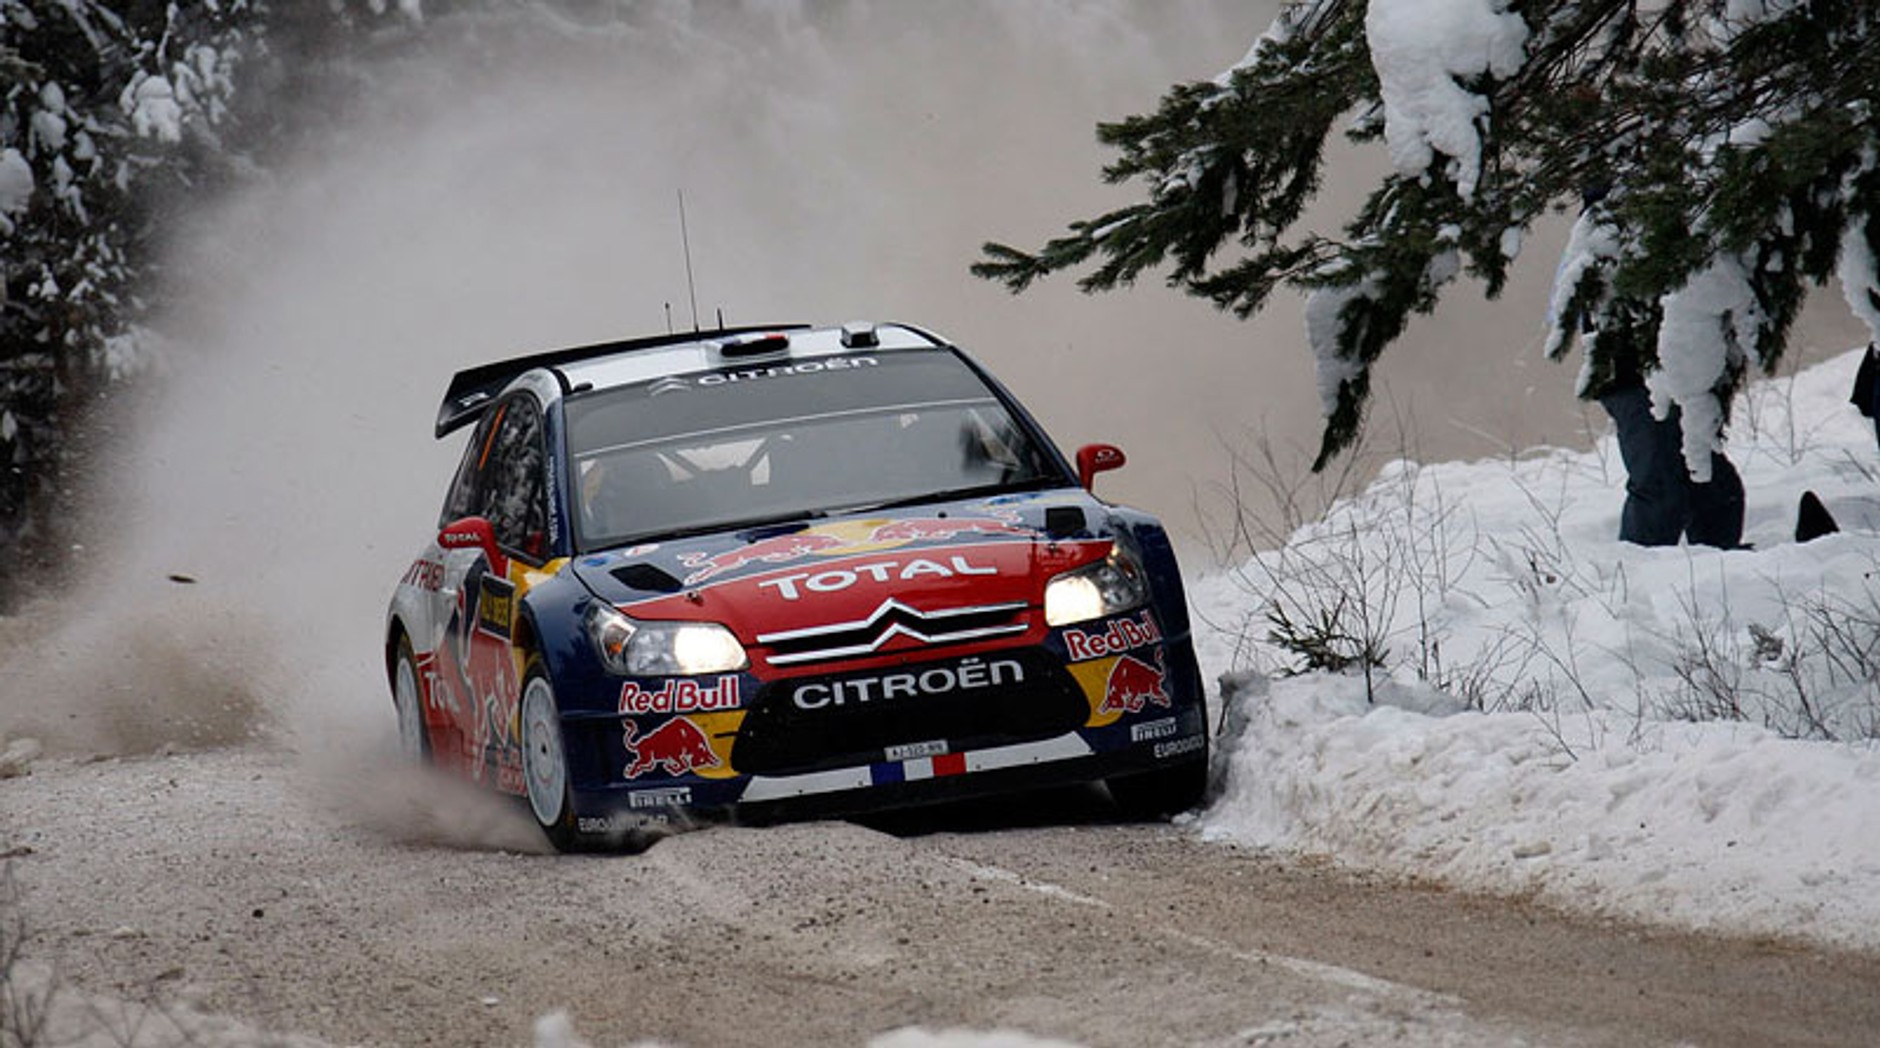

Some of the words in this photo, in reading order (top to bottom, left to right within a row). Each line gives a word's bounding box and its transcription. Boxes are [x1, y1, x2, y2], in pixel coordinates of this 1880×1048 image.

[758, 556, 998, 600] TOTAL
[1063, 620, 1127, 661] Red
[618, 679, 675, 715] Red
[674, 675, 740, 712] Bull
[793, 657, 1025, 710] CITROËN
[628, 786, 692, 808] PIRELLI
